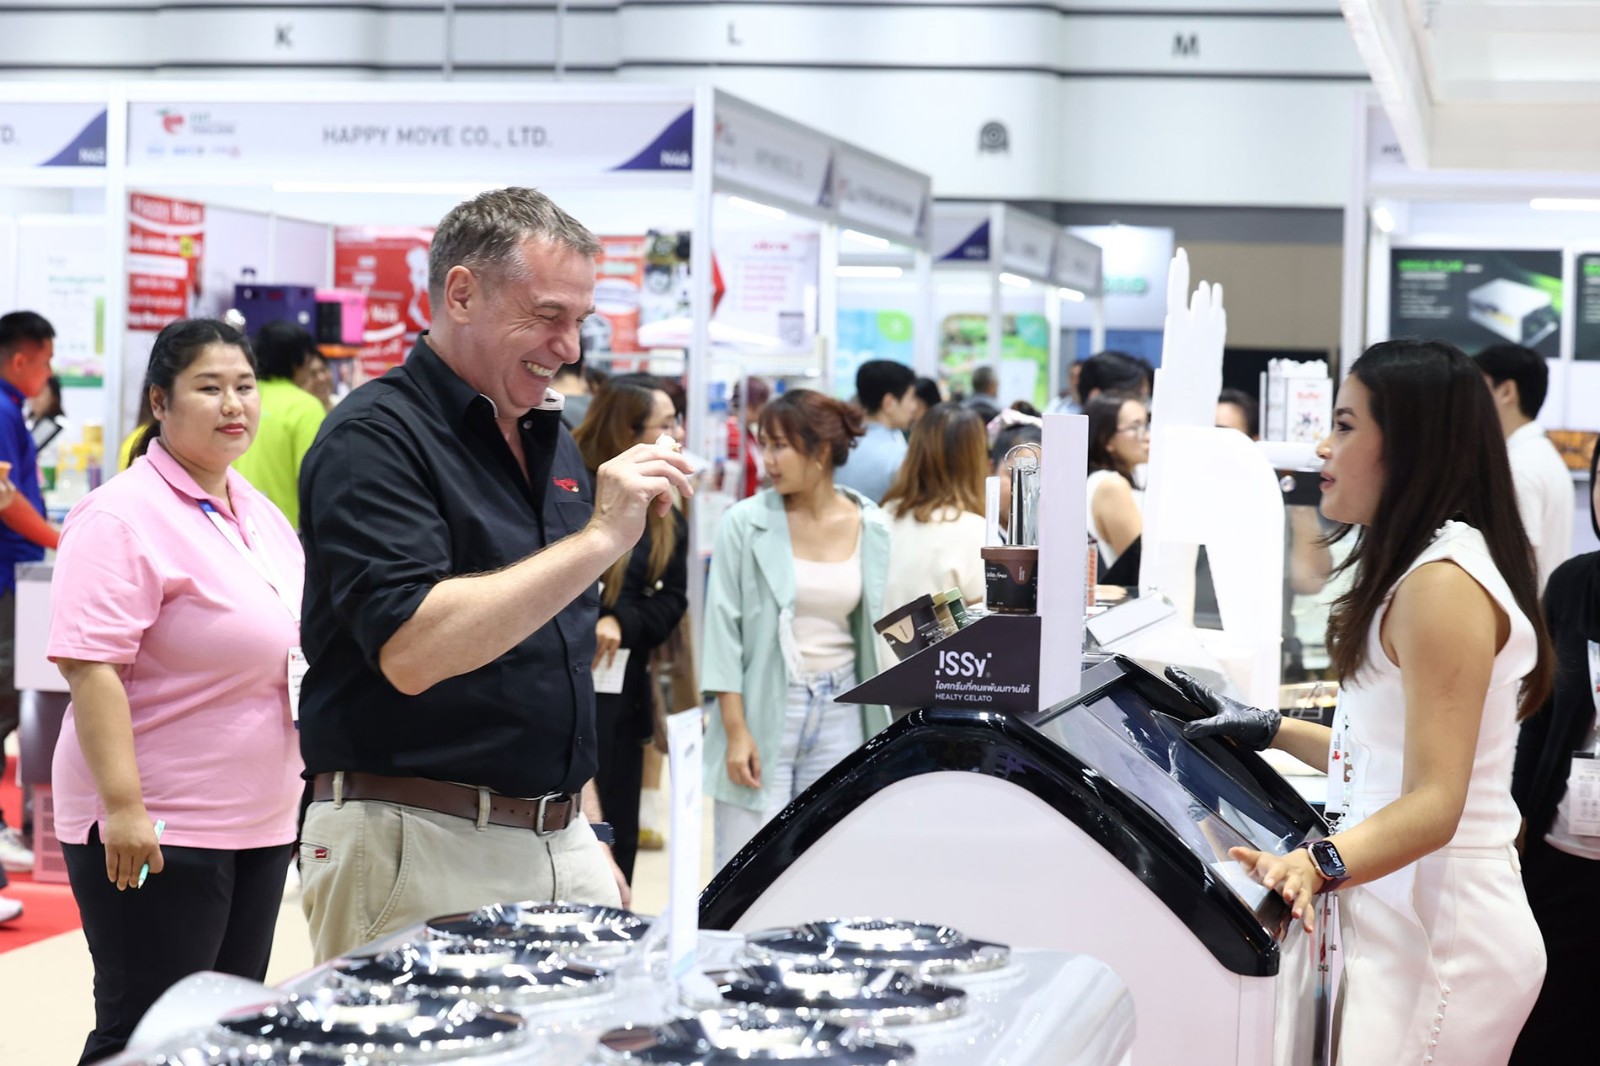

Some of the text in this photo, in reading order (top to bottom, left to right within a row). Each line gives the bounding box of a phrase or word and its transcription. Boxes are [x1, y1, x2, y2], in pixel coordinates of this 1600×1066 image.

[275, 25, 293, 46] K
[728, 23, 743, 45] L
[1172, 33, 1200, 58] M
[0, 124, 20, 146] D.
[322, 125, 389, 147] HAPPY
[397, 125, 452, 147] MOVE
[507, 125, 553, 148] LTD.
[935, 693, 993, 703] HEALTY GELATO
